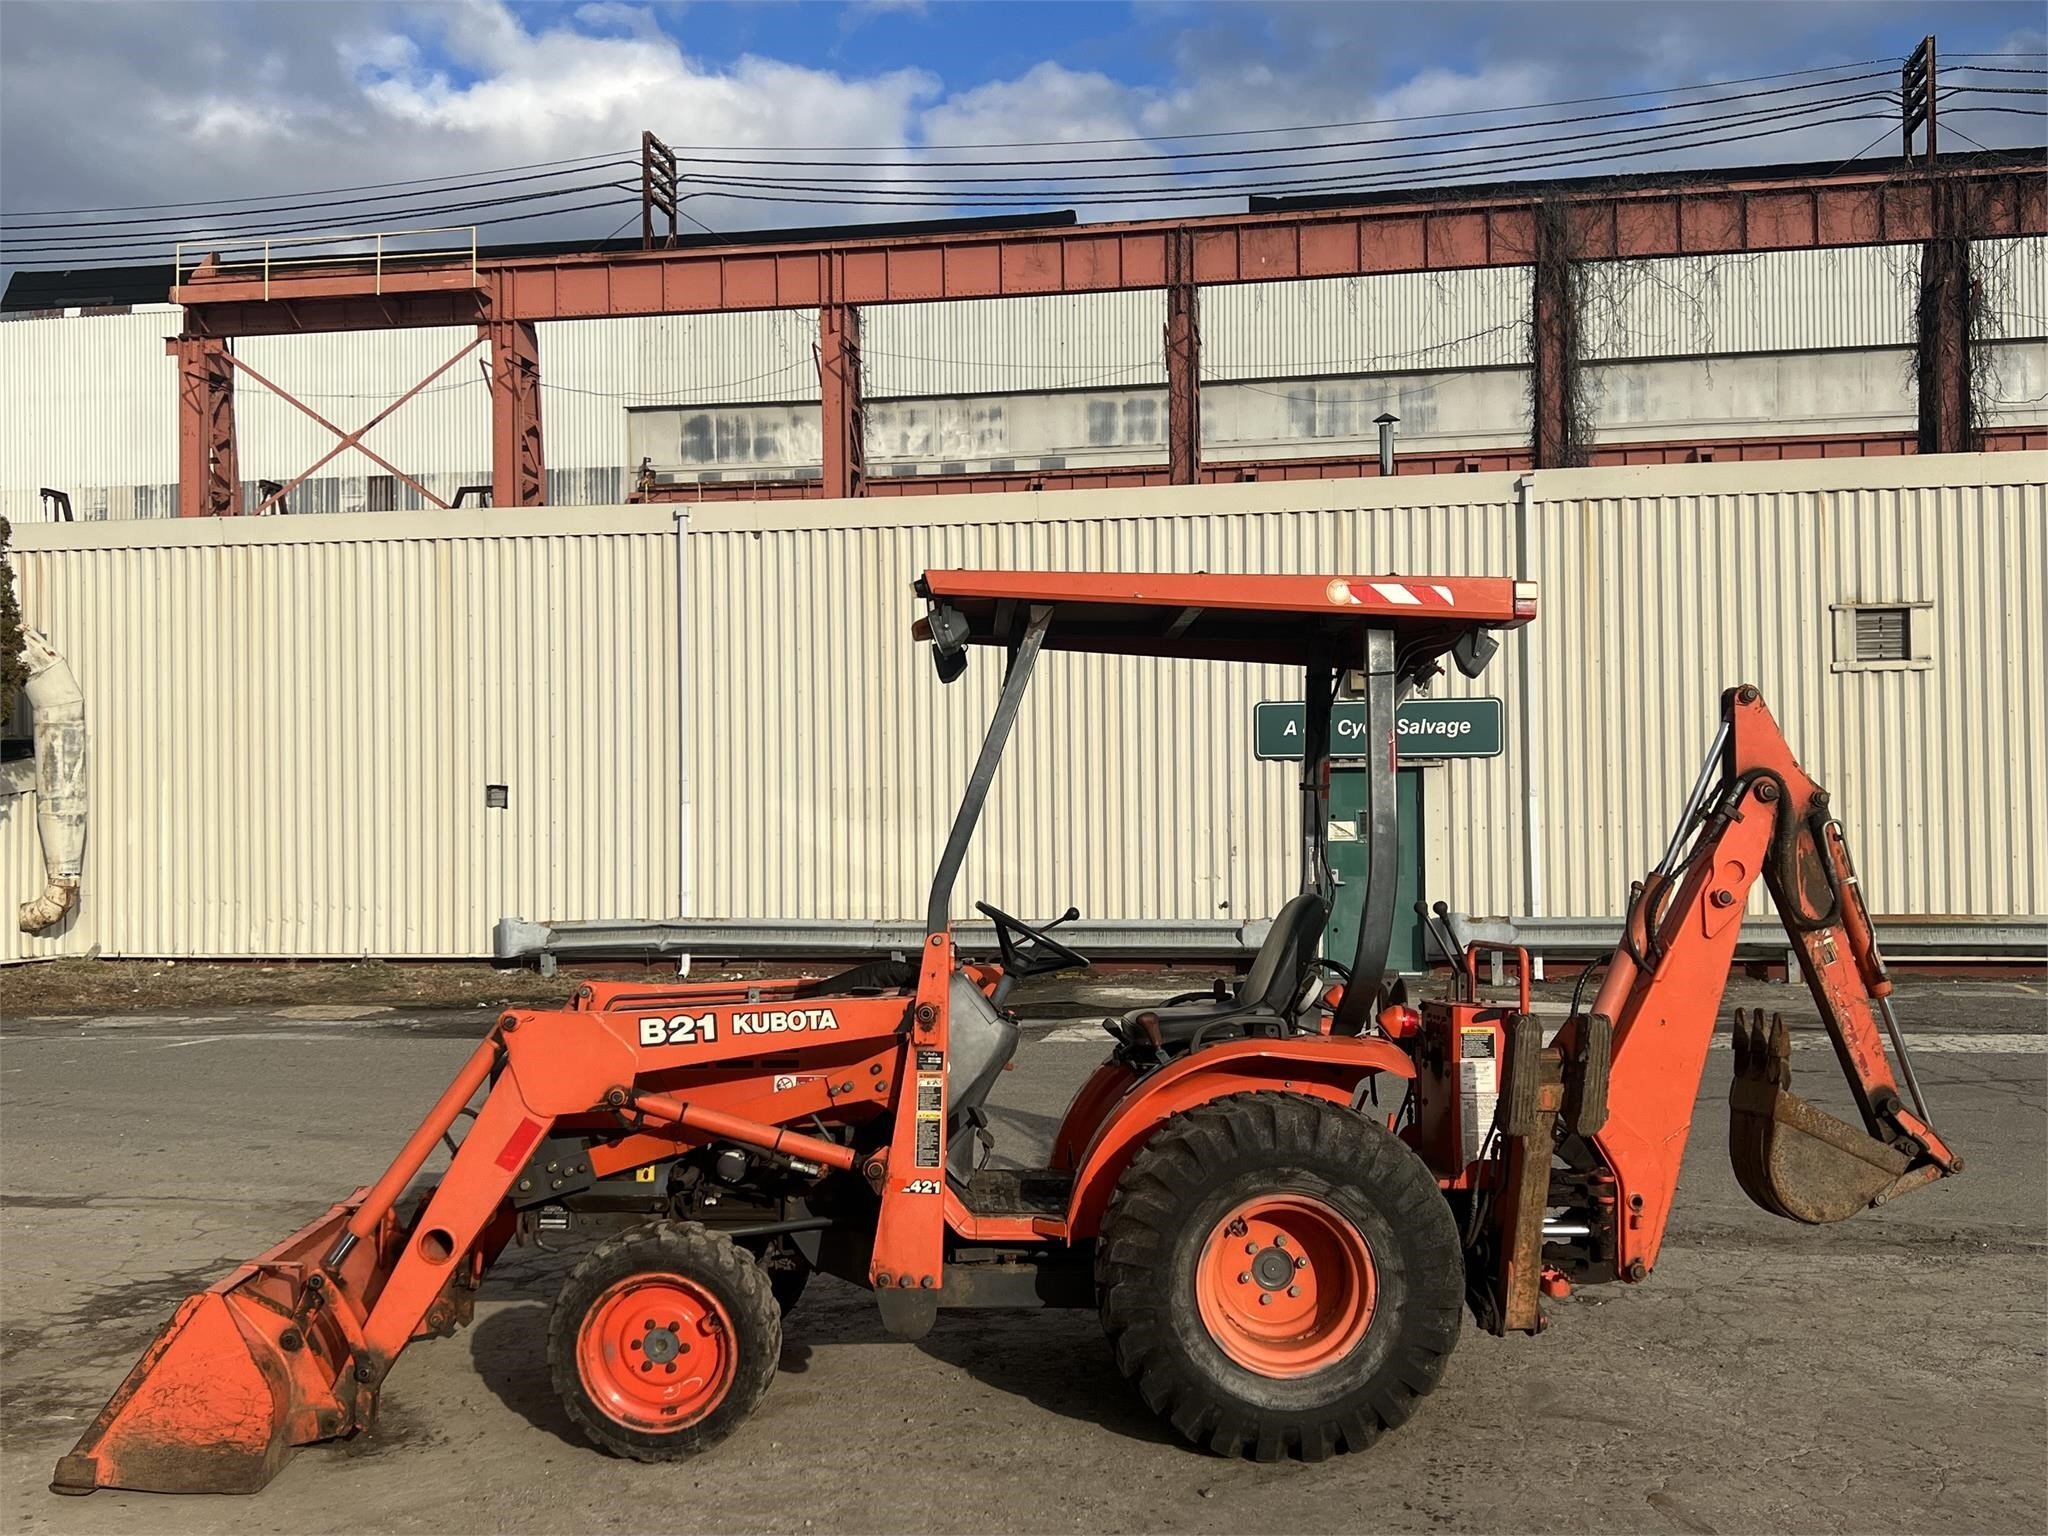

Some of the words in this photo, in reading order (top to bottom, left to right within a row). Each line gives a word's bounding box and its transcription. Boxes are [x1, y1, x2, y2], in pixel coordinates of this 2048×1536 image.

[1283, 720, 1297, 735] A
[1337, 719, 1366, 739] Cy
[1396, 718, 1471, 738] Salvage
[639, 1013, 717, 1046] B21
[732, 1009, 838, 1034] KUBOTA
